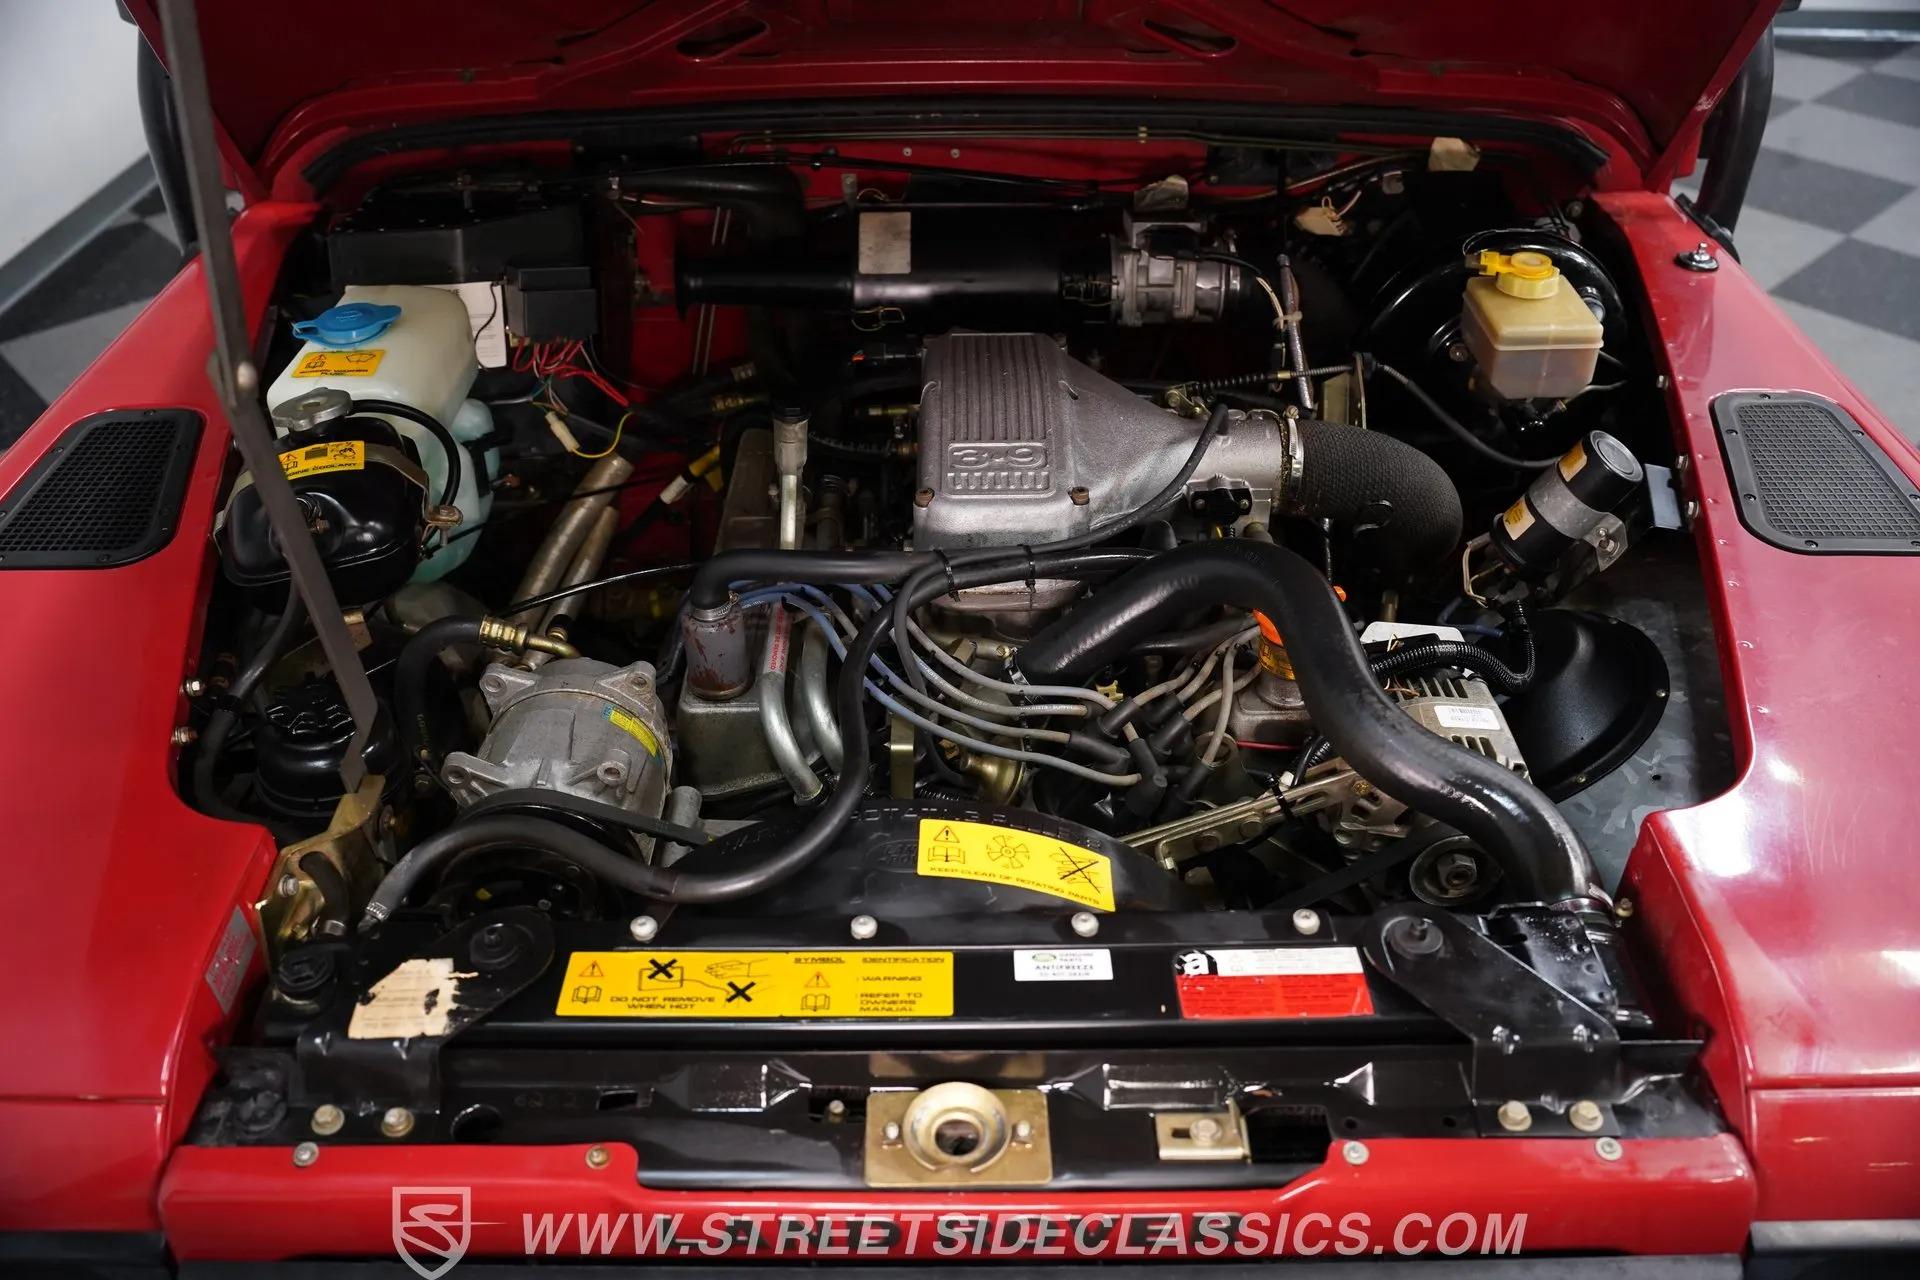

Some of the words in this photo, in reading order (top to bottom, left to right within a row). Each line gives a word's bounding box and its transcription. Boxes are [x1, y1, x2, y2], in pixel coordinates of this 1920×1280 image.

[961, 869, 996, 878] CLEAR
[1016, 878, 1064, 893] ROTATING
[1068, 891, 1100, 904] PARTS
